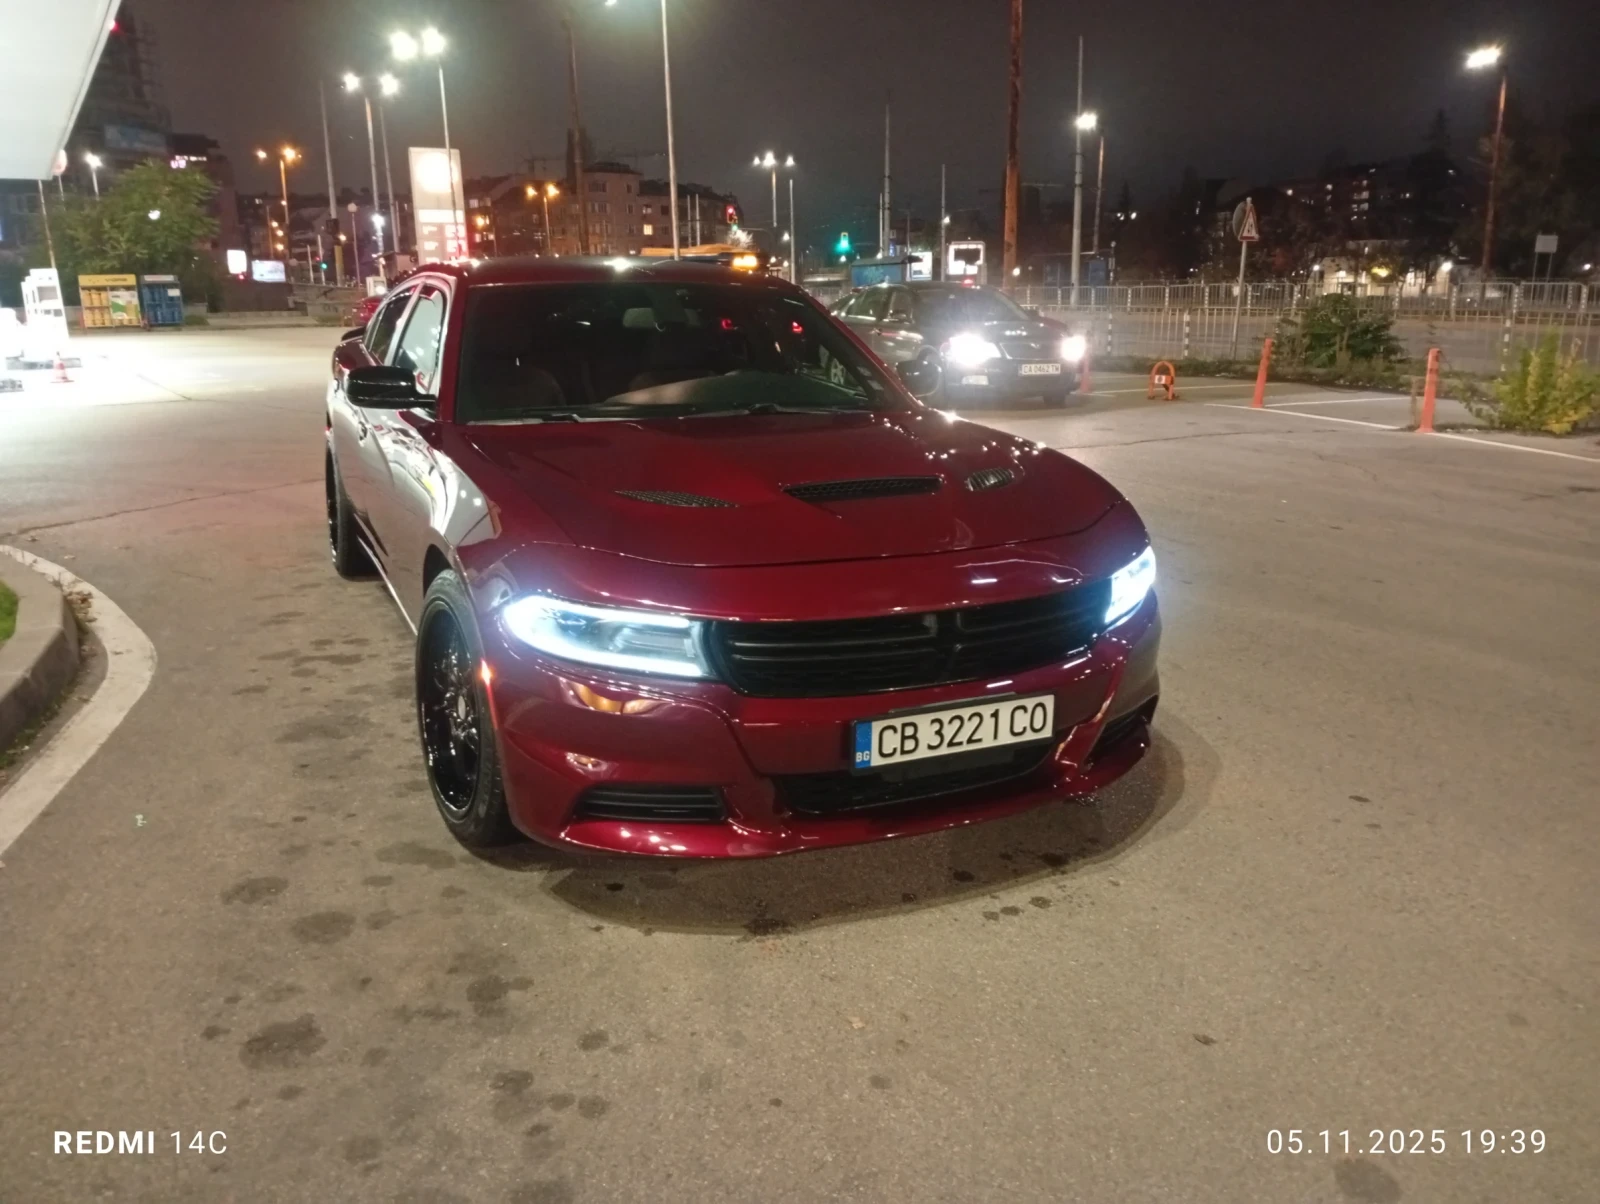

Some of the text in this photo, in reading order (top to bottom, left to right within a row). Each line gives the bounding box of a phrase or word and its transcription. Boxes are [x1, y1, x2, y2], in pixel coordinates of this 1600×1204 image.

[1023, 365, 1033, 374] CA
[877, 702, 1048, 759] CB 3221 CO
[855, 751, 870, 762] BG
